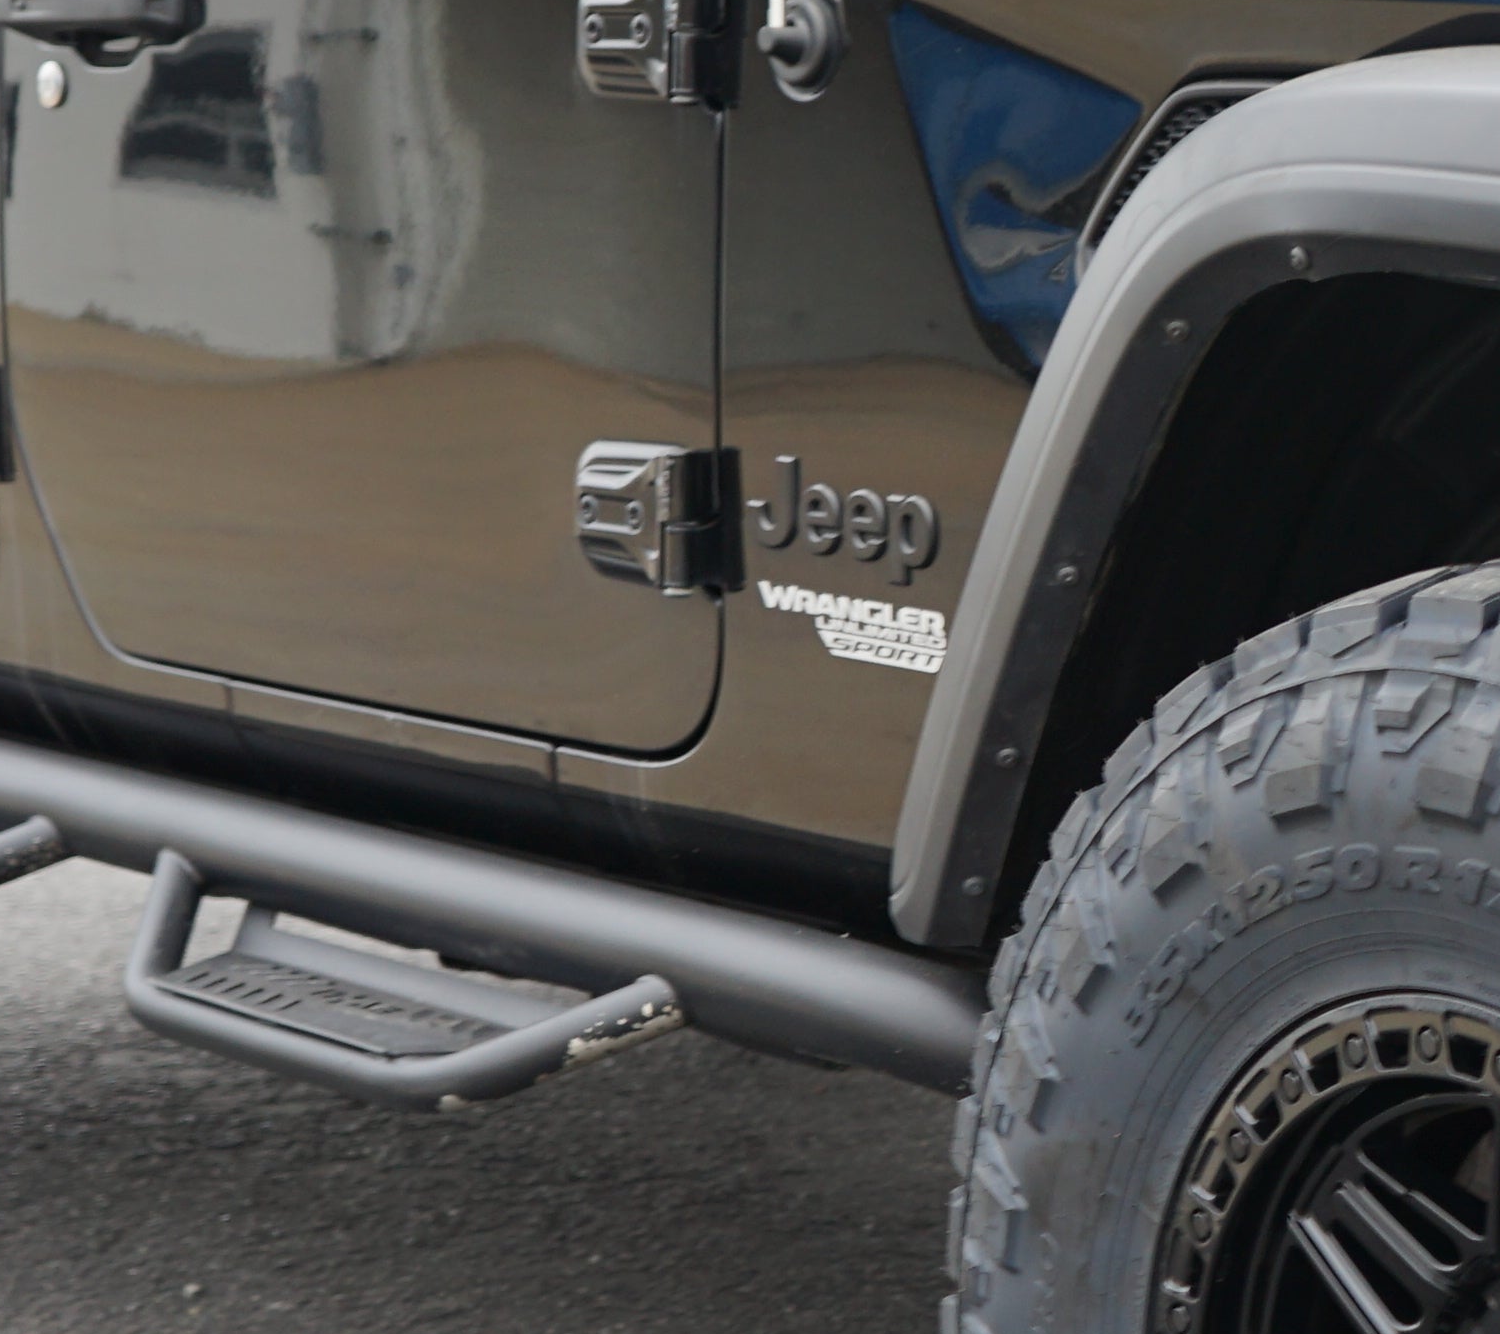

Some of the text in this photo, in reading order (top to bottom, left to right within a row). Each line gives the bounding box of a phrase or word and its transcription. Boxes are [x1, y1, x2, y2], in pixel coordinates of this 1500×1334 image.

[747, 454, 939, 586] Jeep
[757, 580, 946, 638] WRANGLER
[833, 637, 944, 667] SPORT
